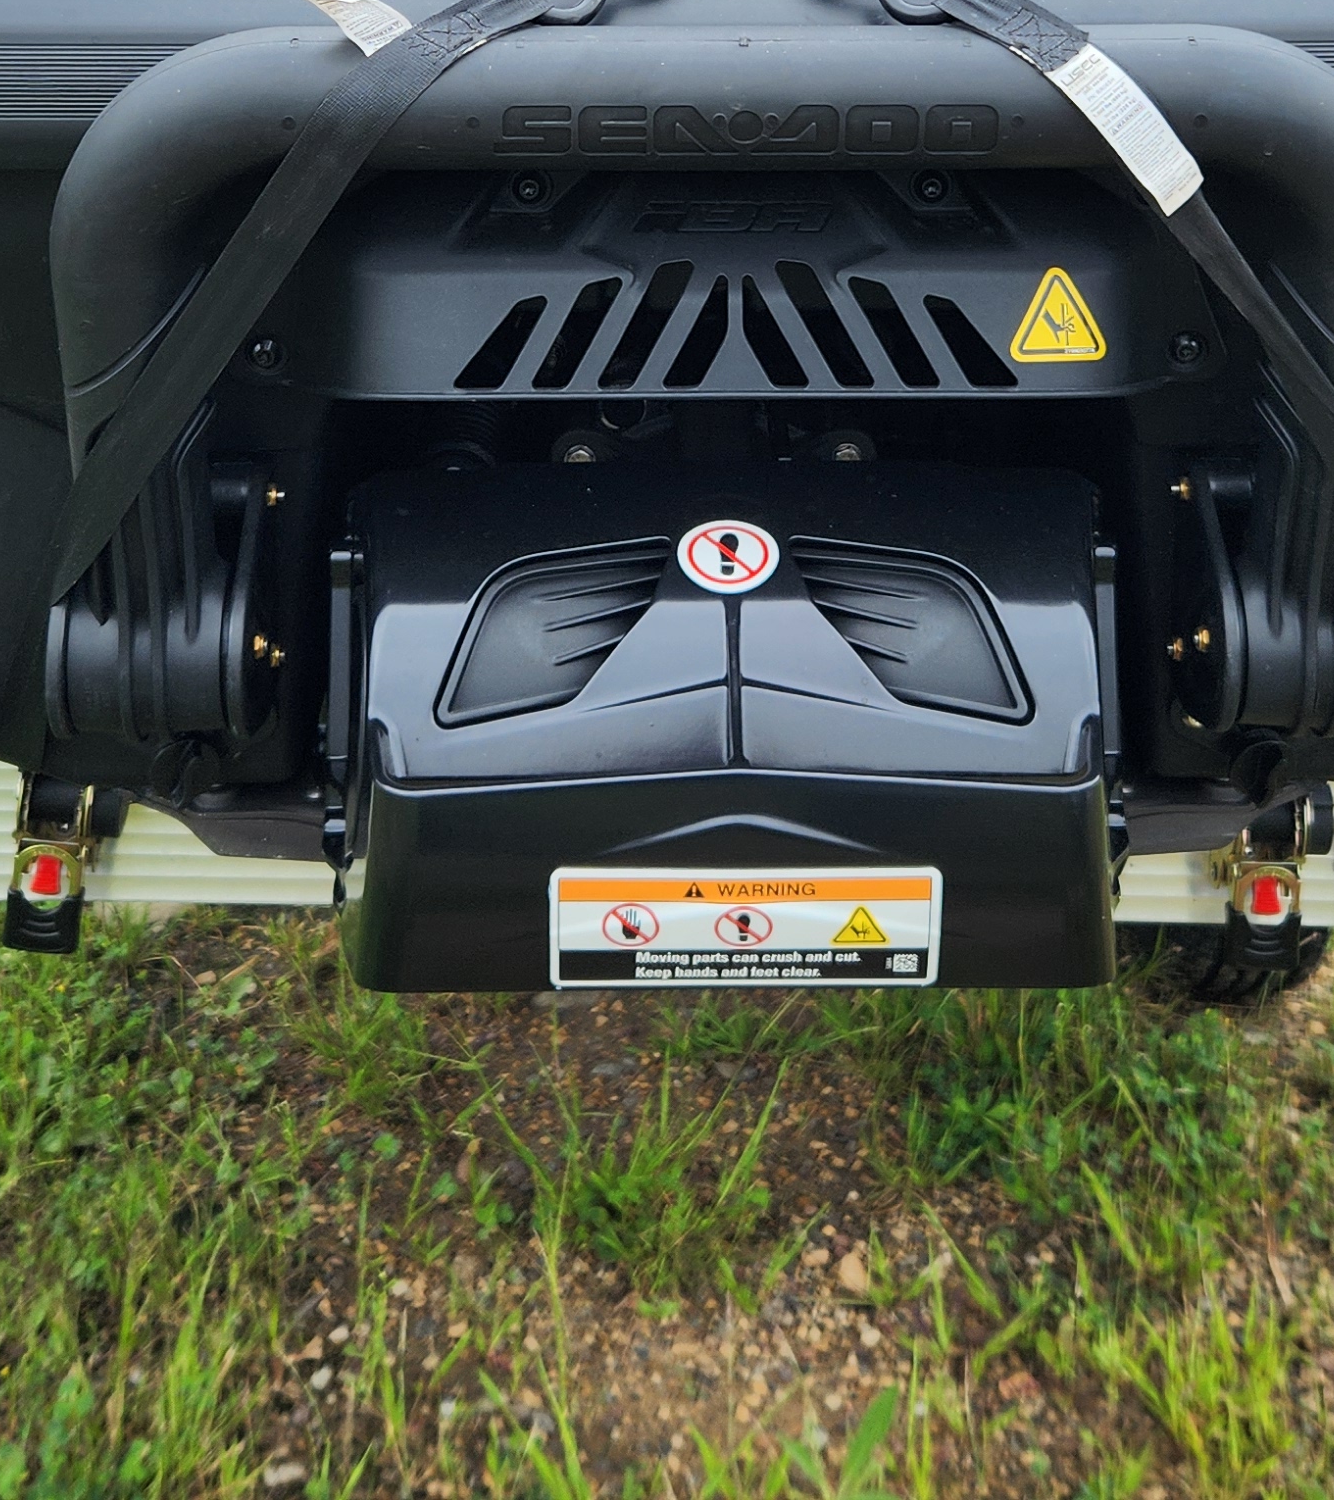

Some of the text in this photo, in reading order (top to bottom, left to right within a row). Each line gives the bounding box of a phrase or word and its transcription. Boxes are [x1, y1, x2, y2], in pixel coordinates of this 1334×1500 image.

[717, 883, 816, 896] WARNING
[635, 951, 862, 965] Moving parts can crush and cut.
[635, 966, 822, 979] Keep hands and feet clear.
